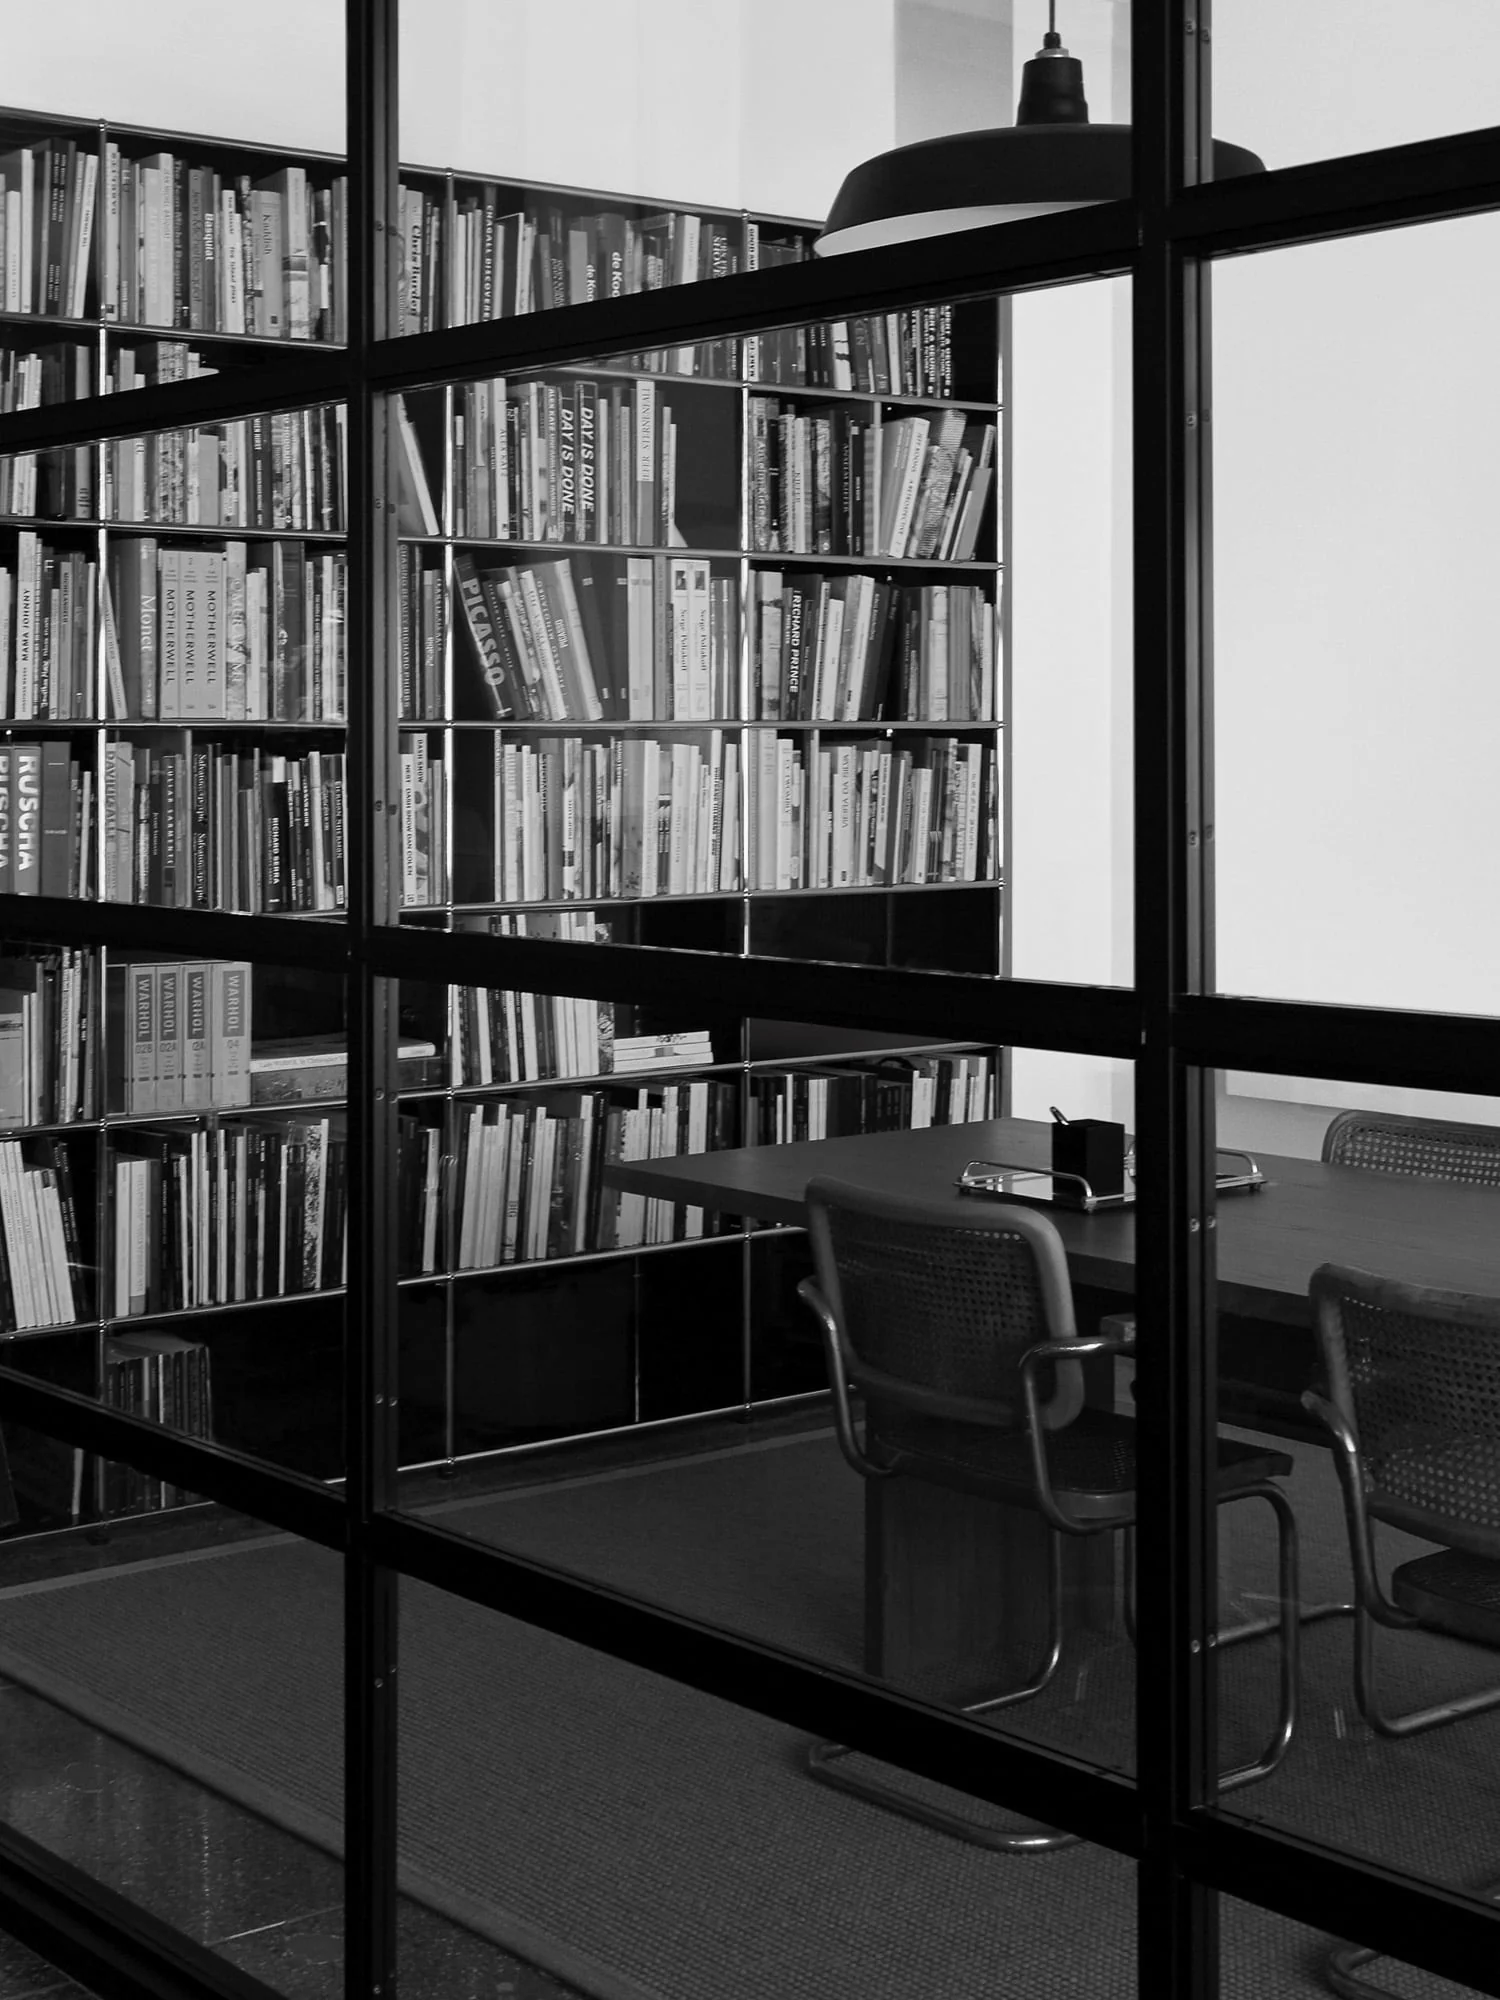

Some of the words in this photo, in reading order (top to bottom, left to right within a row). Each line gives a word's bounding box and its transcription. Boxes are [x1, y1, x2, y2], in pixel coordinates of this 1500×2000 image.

[203, 213, 215, 261] Basquiat
[410, 225, 421, 263] Chris
[612, 252, 622, 269] de
[410, 266, 421, 317] Burden
[483, 258, 493, 322] DISCOVERE
[561, 408, 575, 442] DAY
[580, 407, 594, 440] DAY
[561, 444, 574, 462] IS
[580, 442, 594, 460] IS
[561, 465, 575, 515] DONE
[580, 463, 595, 513] DONE
[22, 587, 32, 629] JOHNNY
[140, 594, 157, 653] Monet
[679, 609, 689, 630] Serge
[698, 609, 708, 630] Serge
[791, 595, 803, 647] RICHARD
[21, 632, 31, 662] MAMA
[163, 588, 176, 685] MOTHERWELL
[184, 589, 197, 685] MOTHERWELL
[206, 589, 218, 685] MOTHERWELL
[462, 577, 506, 687] PICASSO
[680, 633, 689, 672] Poliakoff
[699, 633, 708, 672] Poliakoff
[789, 648, 801, 693] PRINCE
[416, 739, 425, 760] DASH
[416, 761, 425, 784] SNOW
[841, 780, 851, 795] DA
[17, 754, 39, 872] RUSCHA
[405, 787, 415, 809] DASH
[273, 817, 281, 853] RICHARD
[405, 810, 415, 833] SNOW
[272, 855, 281, 885] SERRA
[406, 851, 416, 877] COLEN
[138, 978, 149, 1039] WARHOL
[163, 976, 174, 1036] WARHOL
[191, 975, 202, 1034] WARHOL
[230, 975, 241, 1032] WARHOL
